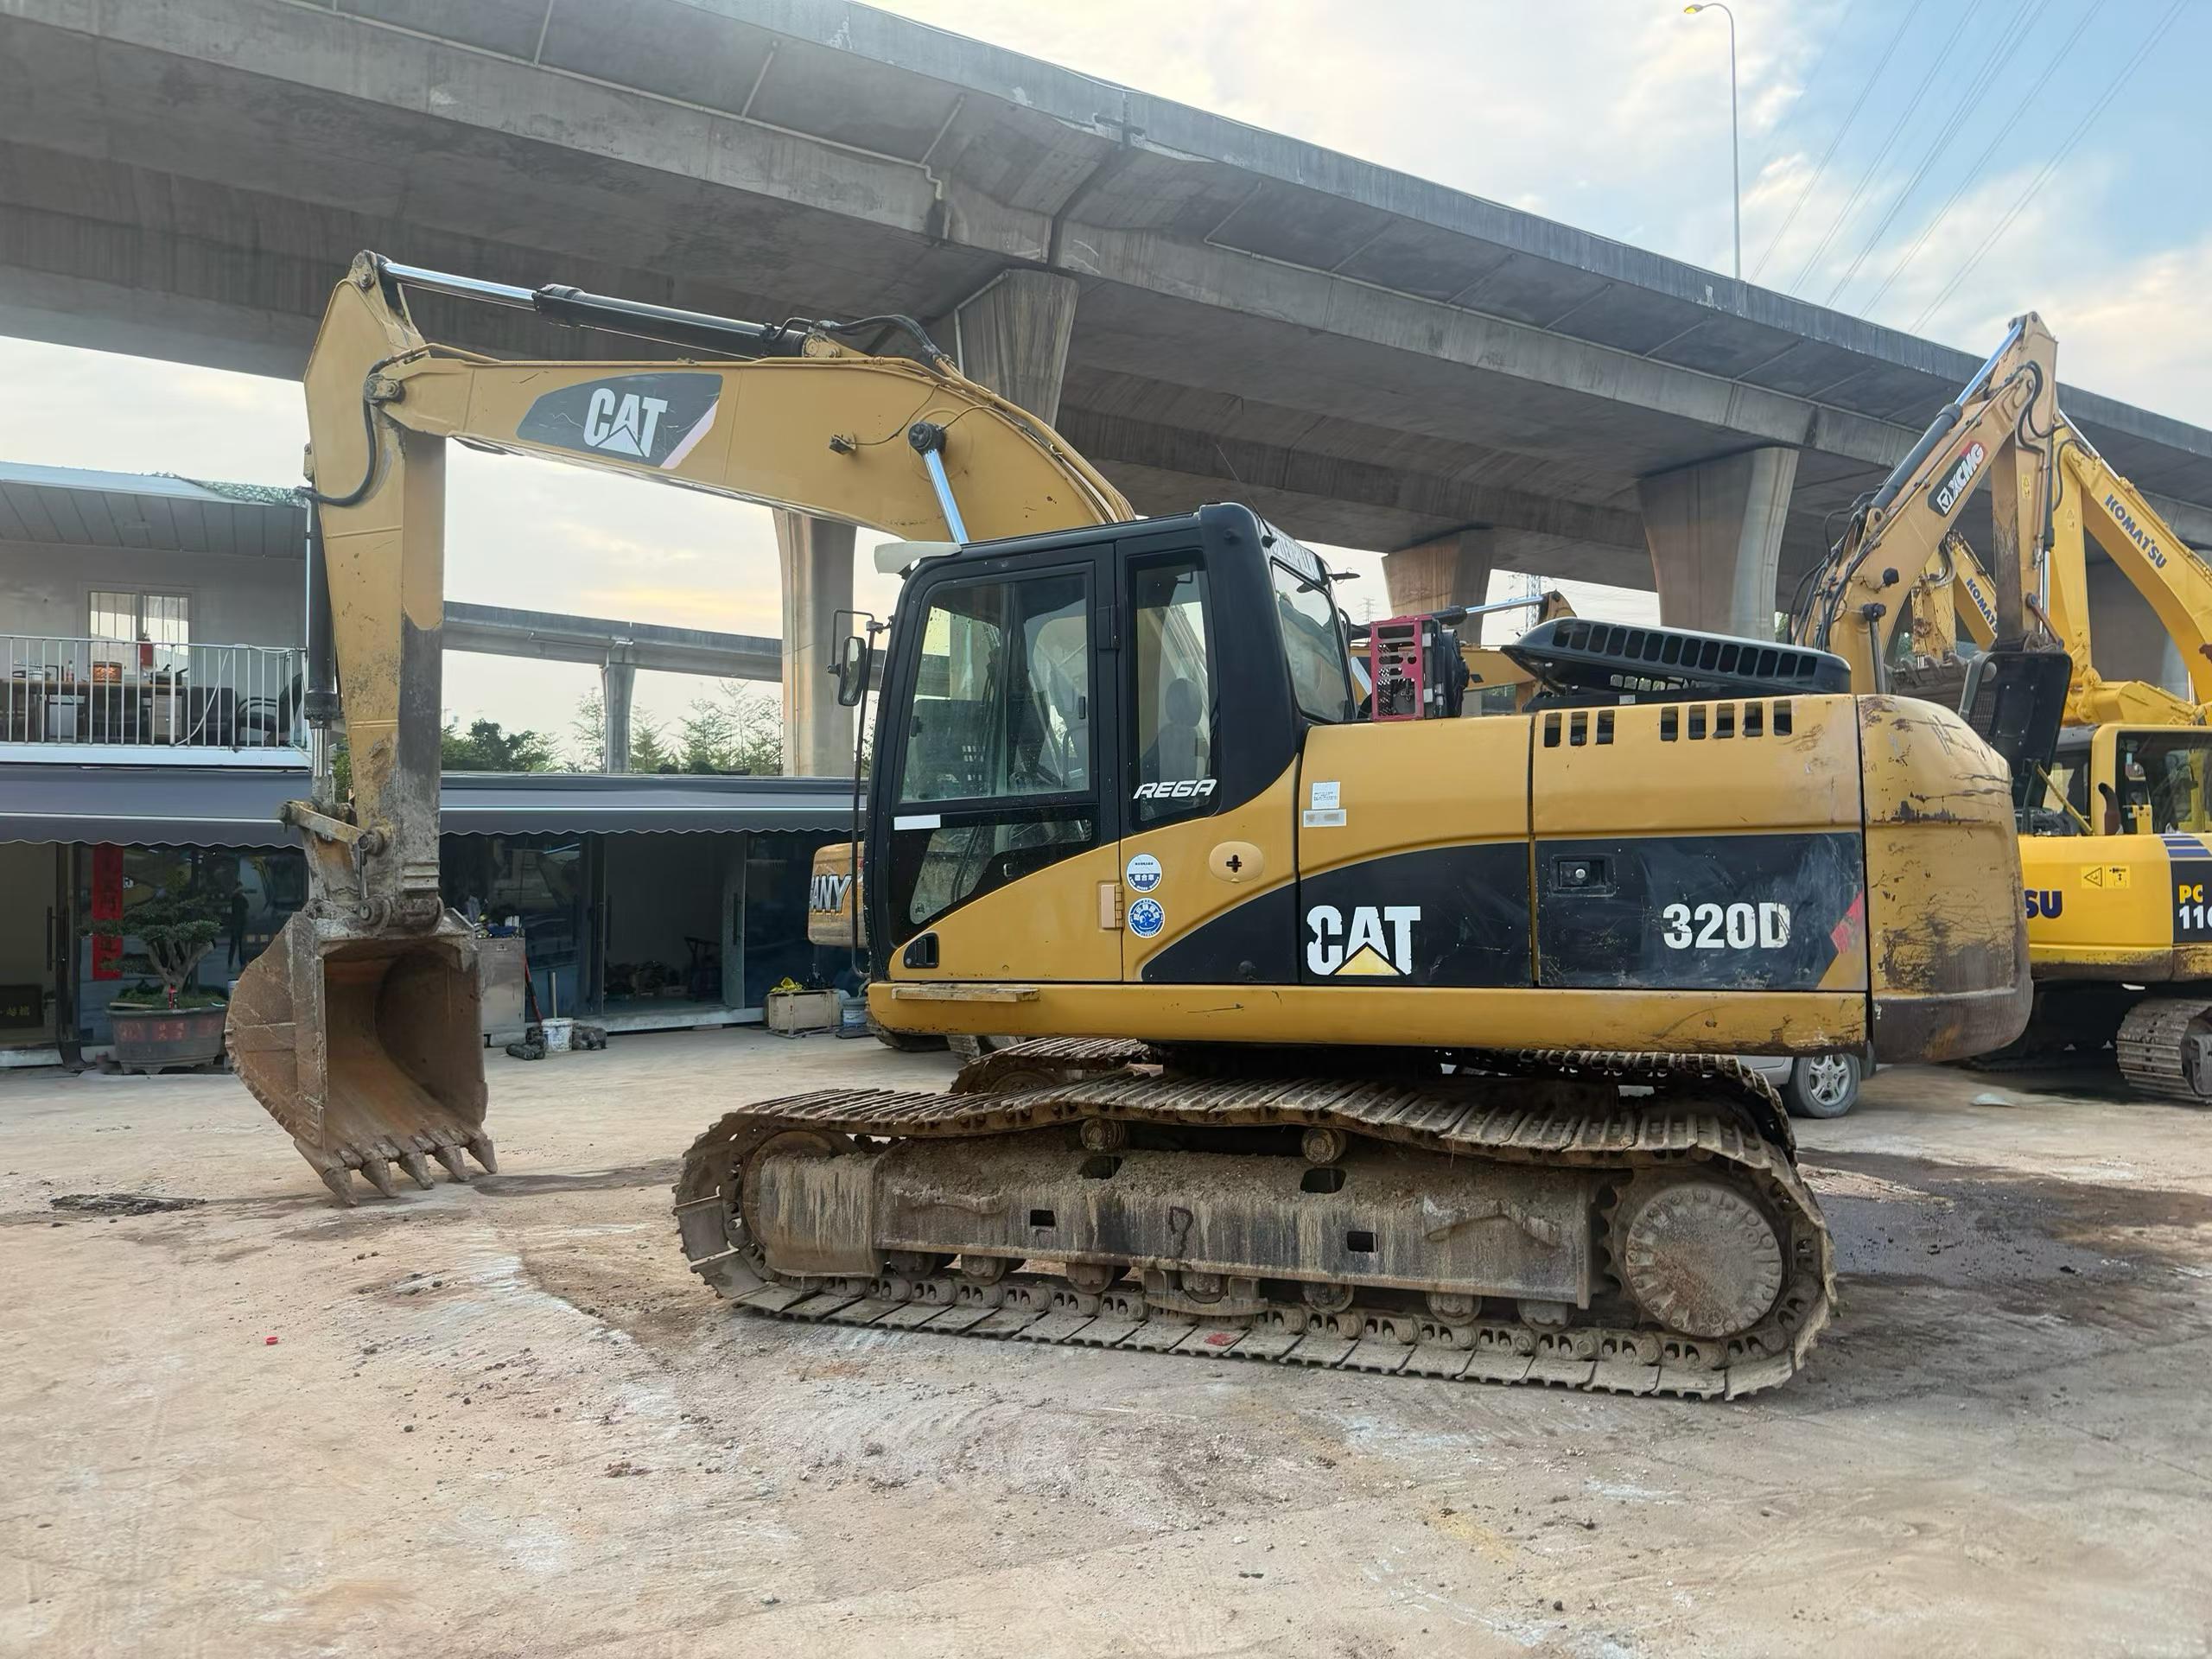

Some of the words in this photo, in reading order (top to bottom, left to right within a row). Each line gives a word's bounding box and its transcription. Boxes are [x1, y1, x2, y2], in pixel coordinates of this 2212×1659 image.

[583, 388, 669, 458] CAT
[1947, 442, 1985, 499] XCMG
[2105, 493, 2167, 569] KOMATSU
[1133, 779, 1217, 799] REGA
[2178, 884, 2203, 904] PC
[1306, 905, 1421, 976] CAT
[1662, 902, 1791, 950] 320D
